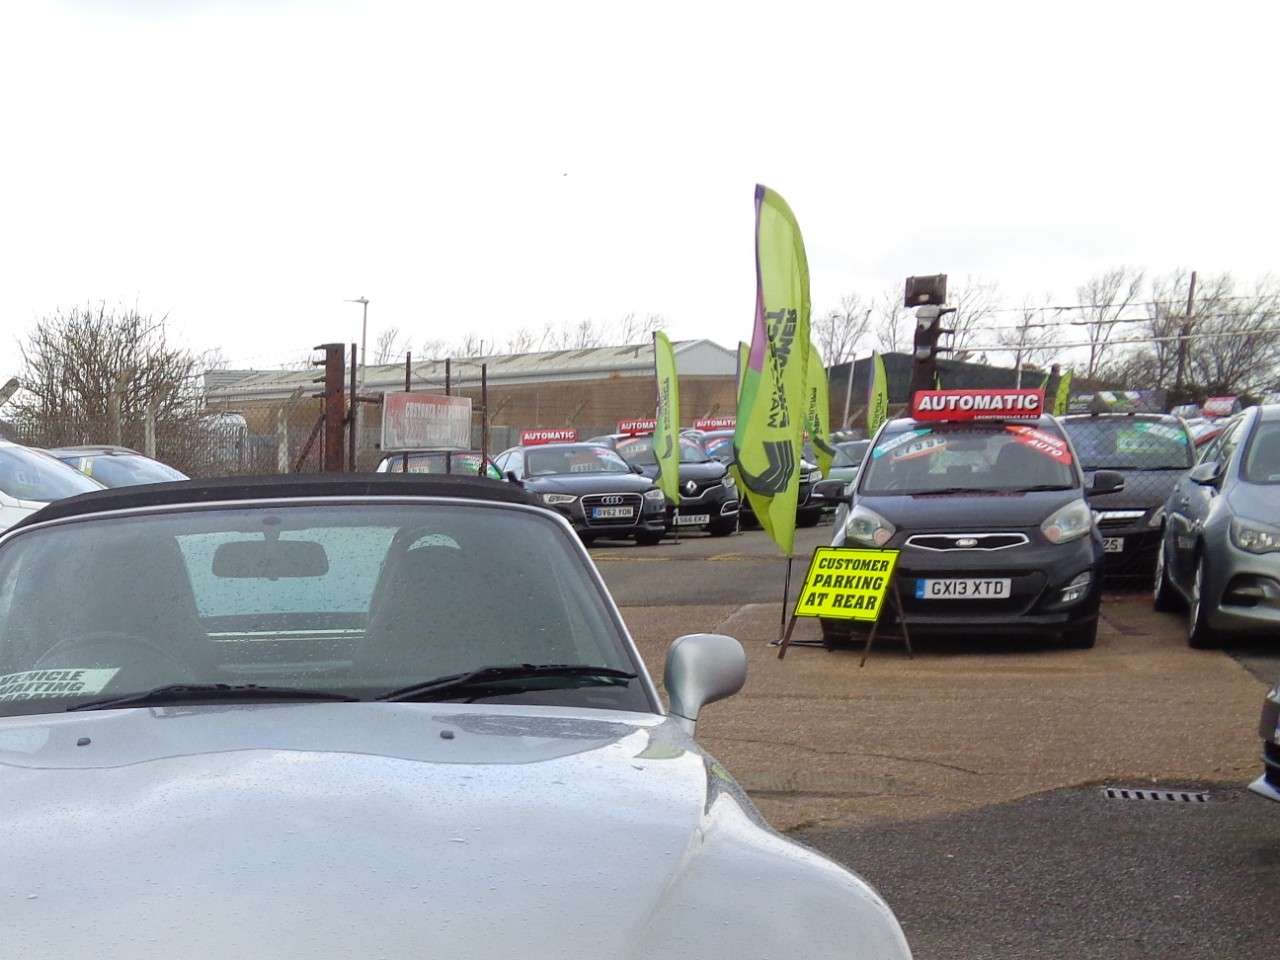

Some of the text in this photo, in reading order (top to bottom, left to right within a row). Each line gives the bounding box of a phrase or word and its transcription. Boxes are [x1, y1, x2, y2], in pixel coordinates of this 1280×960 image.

[918, 394, 1039, 411] AUTOMATIC
[621, 421, 657, 430] AUTOMAT
[524, 431, 575, 440] AUTOMATIC
[1027, 439, 1063, 457] AUTO
[818, 558, 890, 572] CUSTOMER
[812, 574, 884, 591] PARKING
[931, 581, 1004, 595] GX13 XTD
[805, 592, 876, 610] AT REAR
